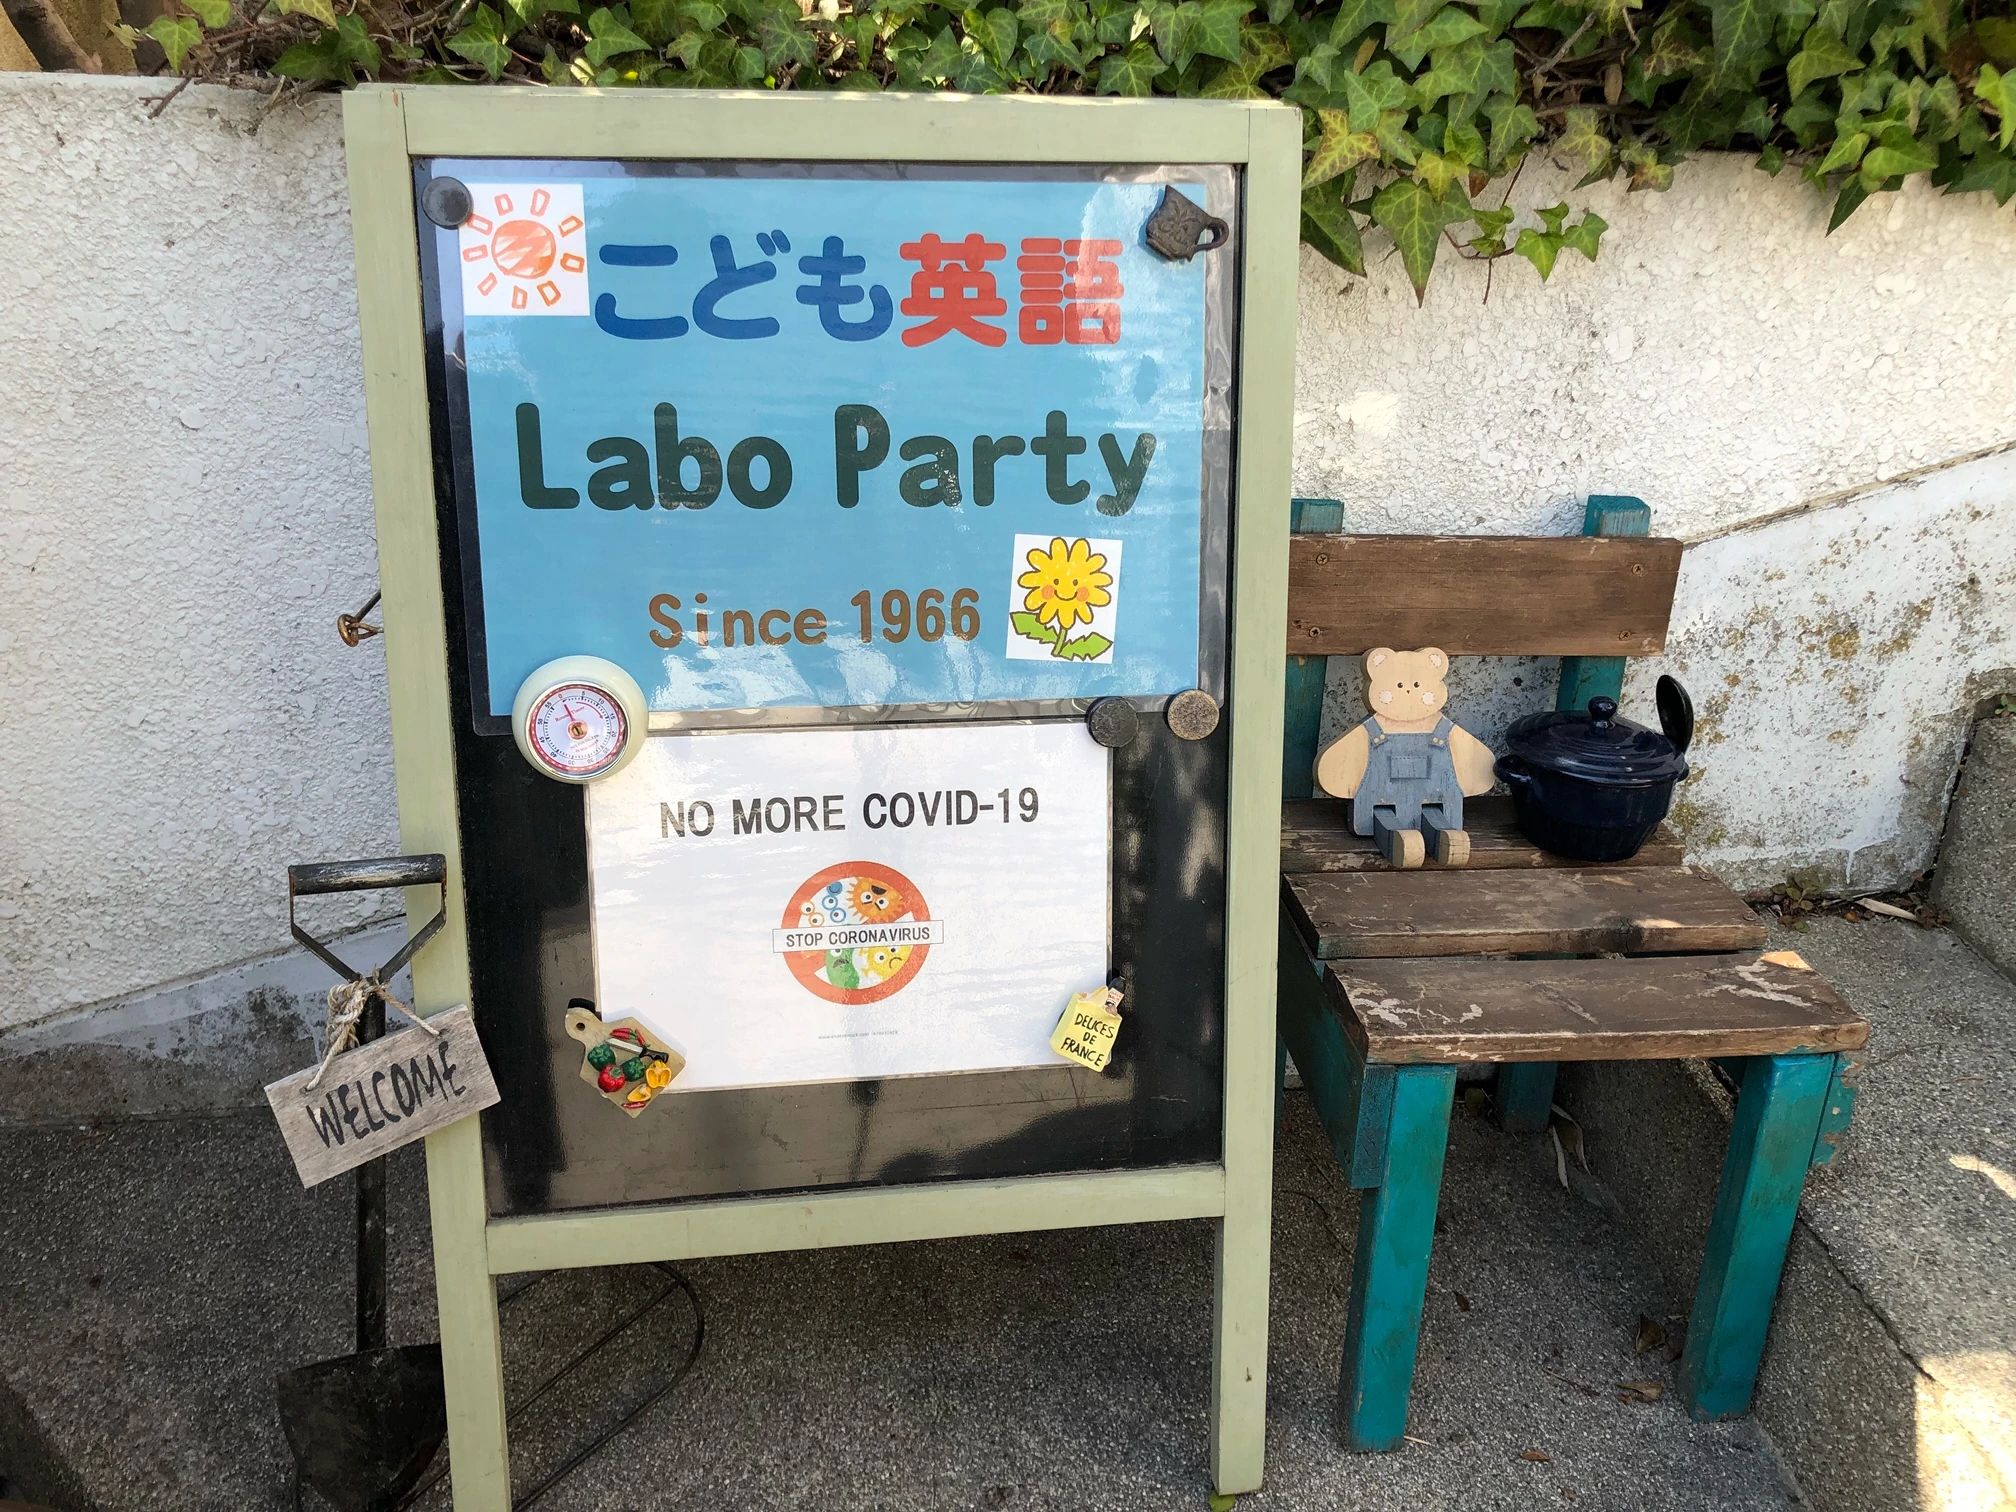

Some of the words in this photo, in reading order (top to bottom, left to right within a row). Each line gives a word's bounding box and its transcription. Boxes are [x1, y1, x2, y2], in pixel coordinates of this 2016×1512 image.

[594, 229, 1125, 347] こども英語
[515, 402, 793, 511] Labo
[834, 403, 1158, 518] Party
[648, 592, 828, 649] Since
[850, 586, 981, 644] 1966
[660, 800, 715, 839] NO
[733, 794, 846, 835] MORE
[863, 787, 1039, 830] COVID-19
[786, 932, 823, 948] STOP
[828, 926, 931, 945] CORONAVIRUS
[1060, 1037, 1105, 1067] FRANCE
[1082, 1031, 1097, 1045] DE
[305, 1040, 466, 1149] WELCOME
